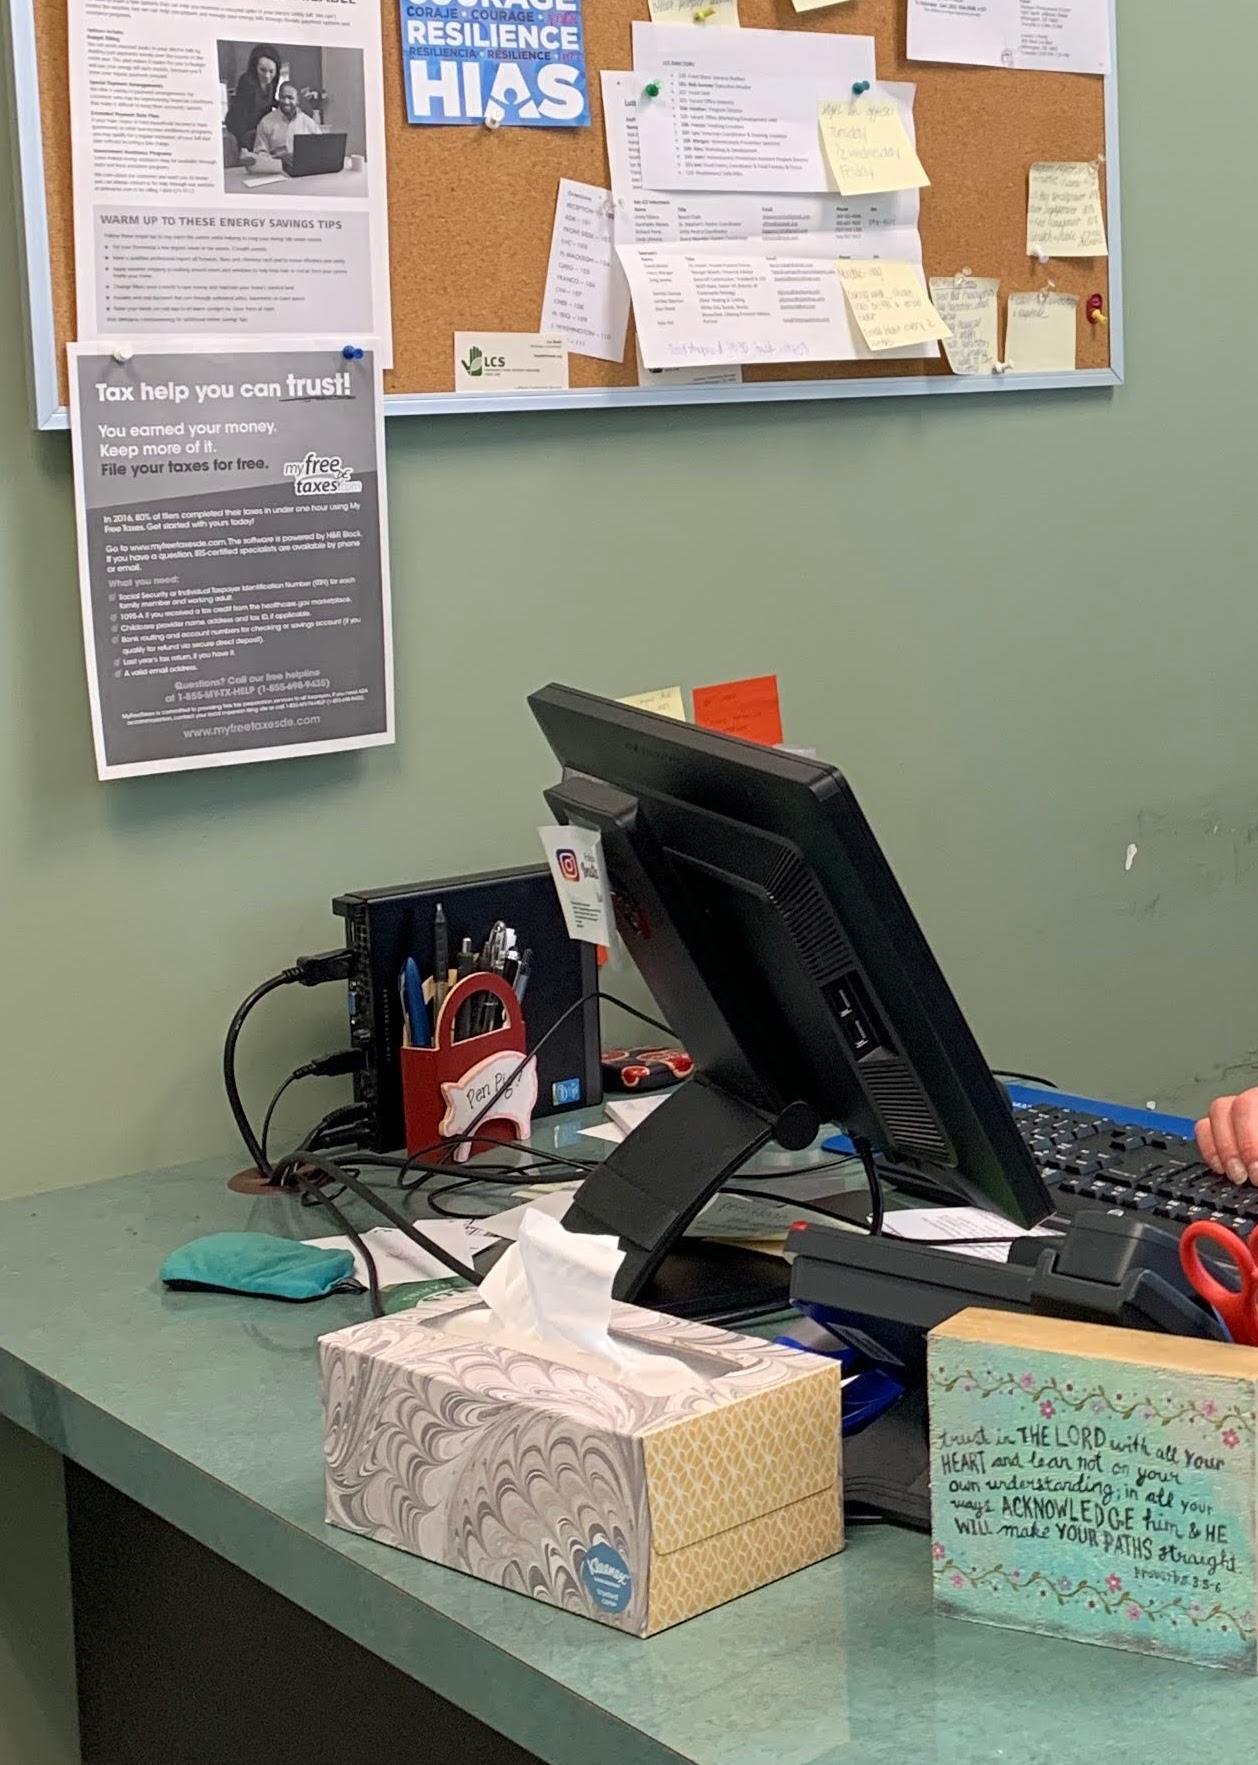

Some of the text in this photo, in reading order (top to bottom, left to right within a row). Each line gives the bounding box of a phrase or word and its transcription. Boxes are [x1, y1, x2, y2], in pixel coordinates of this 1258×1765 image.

[407, 6, 459, 19] CORAJE
[471, 9, 535, 22] COURAGE
[408, 20, 579, 50] RESILIENCE
[410, 60, 584, 119] HIAS
[100, 215, 343, 230] WARM UP TO THESE ENERGY SAVINGS TIPS
[484, 356, 506, 368] LCS
[96, 373, 351, 404] Tax help you can trust!
[97, 422, 277, 439] You earned your money.
[100, 440, 217, 459] Keep more of it.
[101, 458, 269, 478] File your taxes for free.
[152, 513, 161, 521] of
[181, 510, 224, 519] completed
[272, 506, 294, 514] under
[350, 502, 361, 510] My
[104, 525, 122, 533] Free
[146, 523, 162, 531] Get
[163, 521, 190, 530] started
[191, 520, 208, 528] with
[208, 520, 229, 528] yours
[230, 518, 255, 526] today!
[105, 545, 119, 553] Go
[282, 533, 315, 543] powered
[316, 533, 325, 541] by
[326, 531, 341, 539] H&R
[106, 555, 112, 563] If
[113, 556, 128, 564] you
[240, 546, 277, 555] specialists
[292, 542, 328, 550] available
[337, 541, 361, 549] phone
[108, 576, 179, 588] What you need:
[148, 667, 169, 675] email
[174, 670, 321, 690] Questions? Call our free helpline
[165, 694, 175, 703] at
[183, 716, 321, 738] www.myfreetaxesde.com
[467, 1084, 491, 1109] Pen
[939, 1425, 992, 1450] trust
[996, 1428, 1016, 1446] in
[1017, 1424, 1050, 1448] THE
[1056, 1425, 1106, 1450] LORD
[1110, 1435, 1151, 1456] with
[1156, 1444, 1180, 1464] all
[941, 1450, 1183, 1487] HEART and lean not on your
[949, 1479, 981, 1493] own
[1124, 1483, 1139, 1501] in
[1145, 1487, 1174, 1508] all
[1181, 1499, 1213, 1515] your
[950, 1495, 1228, 1544] ways ACKNOWLEDGE him & HE
[955, 1517, 993, 1536] WILL
[997, 1521, 1050, 1539] make
[1055, 1523, 1099, 1547] YOUR
[1103, 1531, 1153, 1560] PATHS
